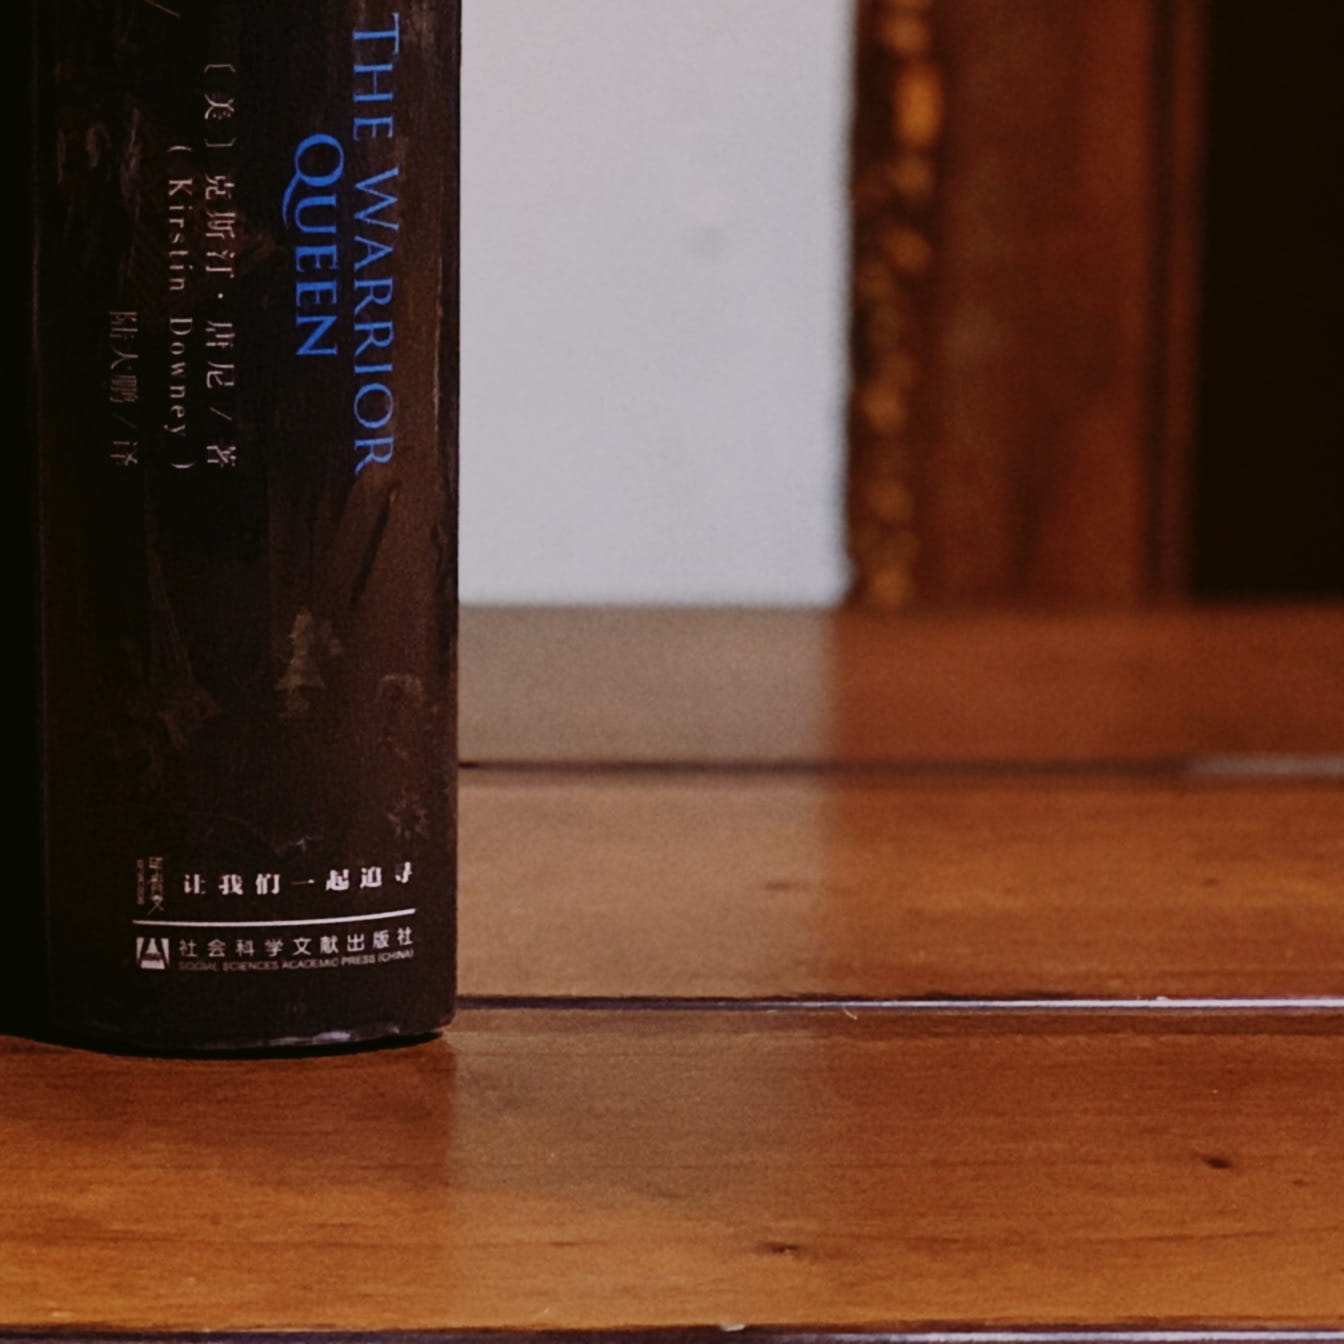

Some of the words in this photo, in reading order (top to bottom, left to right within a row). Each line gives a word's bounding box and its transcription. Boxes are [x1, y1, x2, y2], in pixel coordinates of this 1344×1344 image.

[353, 13, 399, 139] THE
[282, 134, 344, 355] QUEEN
[354, 168, 399, 472] WARRIOR
[184, 862, 412, 895] 让我们一起追寻
[178, 926, 414, 959] 社会科学文献出版社
[341, 954, 376, 967] PRESS
